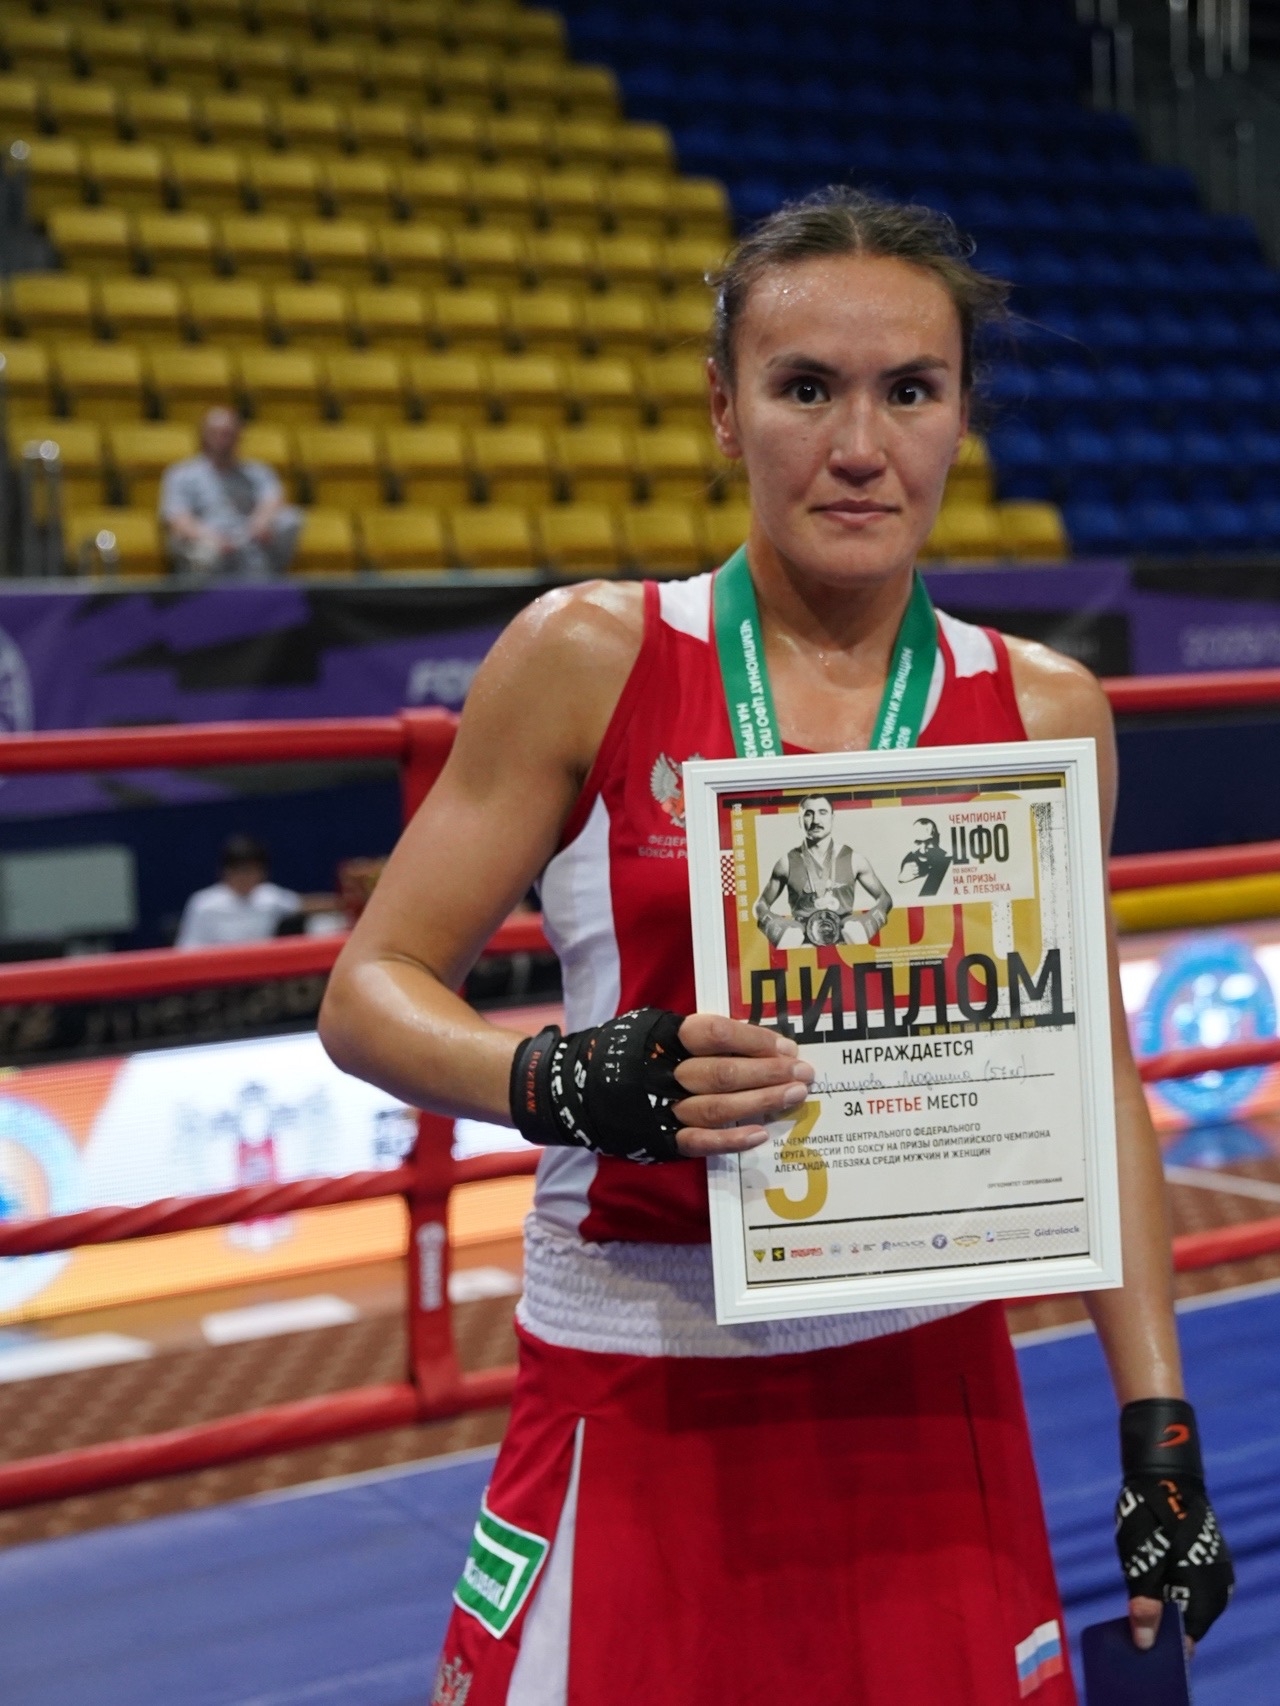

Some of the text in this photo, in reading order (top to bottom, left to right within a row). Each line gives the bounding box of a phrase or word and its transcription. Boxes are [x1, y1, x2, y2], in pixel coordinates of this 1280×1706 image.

[740, 619, 763, 694] ЧЕМПИОНАТ
[878, 711, 898, 750] ЖЧИН
[891, 646, 913, 702] ЖЕНЩИН
[752, 695, 769, 727] ЦФО
[736, 702, 758, 758] НА ПРИЗ
[759, 727, 773, 749] ПО
[895, 726, 912, 750] 026
[949, 811, 1007, 824] ЧЕМПИОНАТ
[648, 834, 686, 846] ФЕДЕР
[951, 824, 1010, 865] ЦФО
[953, 874, 996, 884] НА ПРИЗЫ
[973, 883, 1011, 894] ЛЕБЗЯКА
[748, 949, 1064, 1040] ДИПЛОМ
[842, 1040, 974, 1065] НАГРАЖДАЕТСЯ
[844, 1092, 978, 1117] ЗА ТРЕТЬЕ МЕСТО
[773, 1122, 981, 1147] НА ЧЕМПИОНАТЕ ЦЕНТРАЛЬНОГО ФЕДЕРАЛЬНОГО
[774, 1129, 1051, 1160] ОКРУГА РОССИИ ПО БОКСУ НА ПРИЗЫ ОЛИМПИЙСКОГО ЧЕМПИОНА
[764, 1100, 829, 1220] 3
[775, 1161, 830, 1173] АЛЕКСАНДРА
[832, 1157, 870, 1168] ЛЕБЗЯКА
[872, 1155, 901, 1166] СРЕДИ
[903, 1151, 941, 1162] МУЖЧИН
[951, 1147, 991, 1158] ЖЕНЩИН
[1034, 1225, 1080, 1237] Gidrolock
